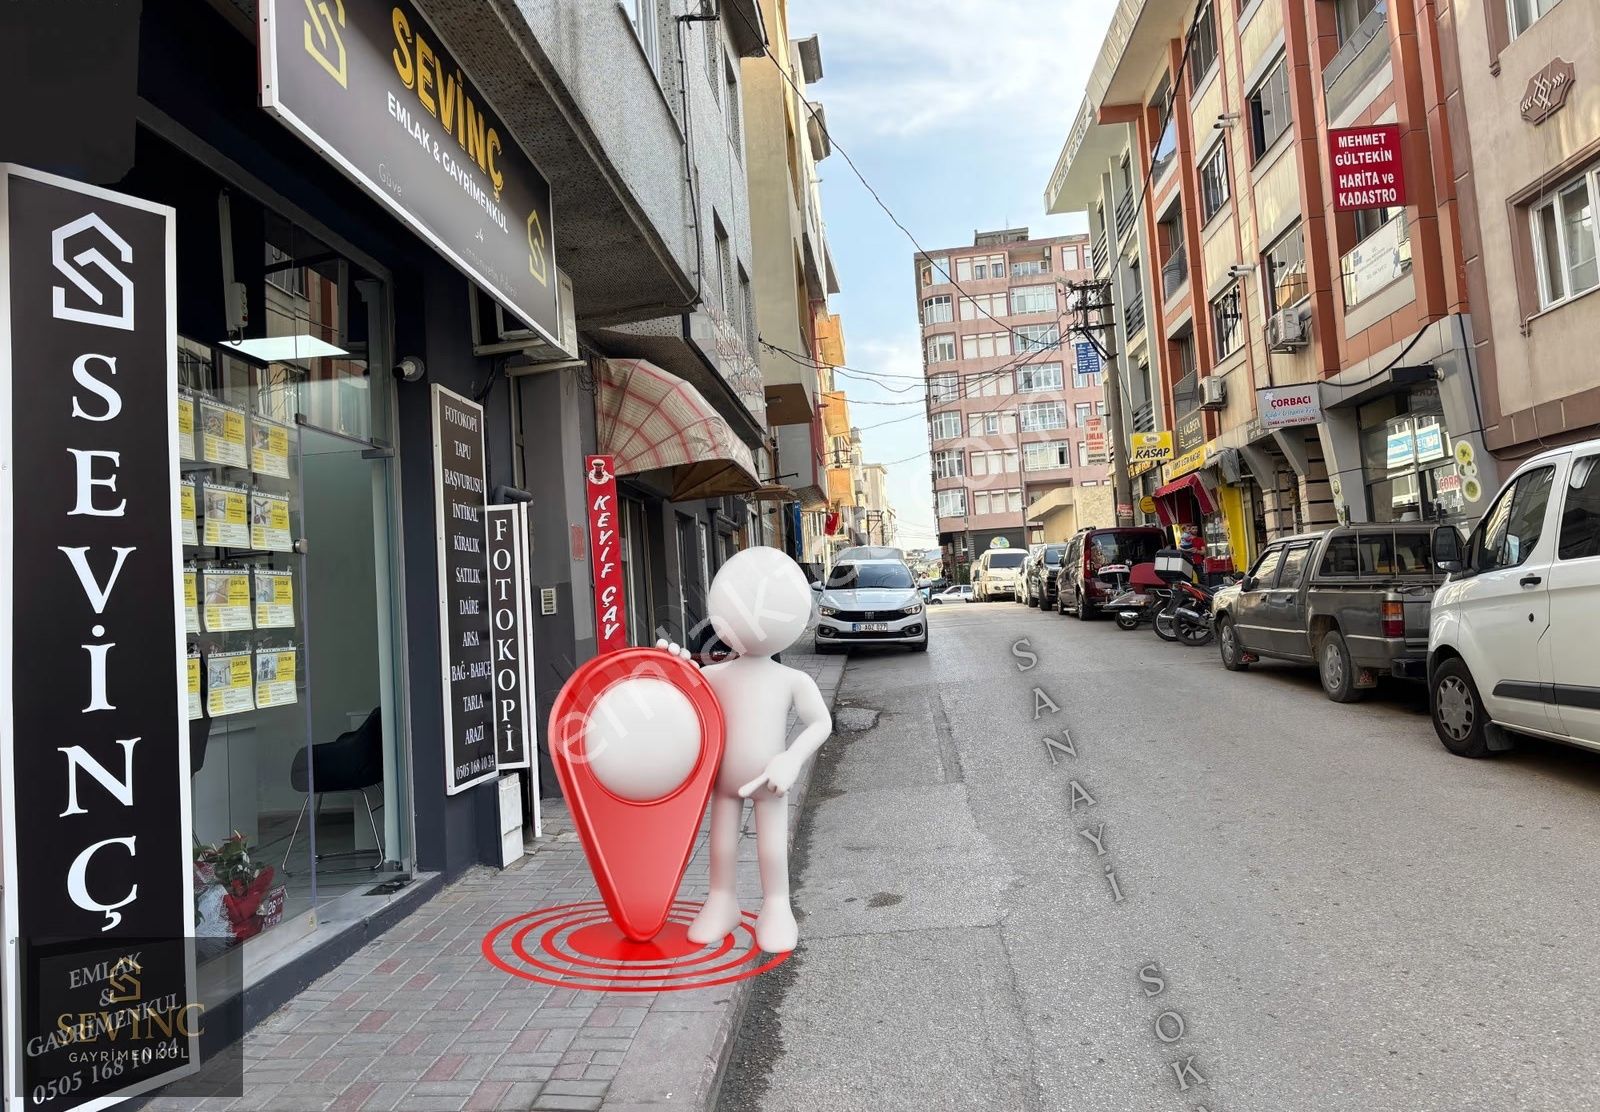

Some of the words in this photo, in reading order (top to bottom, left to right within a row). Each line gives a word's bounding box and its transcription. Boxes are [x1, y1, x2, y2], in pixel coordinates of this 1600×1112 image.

[392, 7, 504, 203] SEVİNÇ
[1338, 133, 1386, 148] MEHMET
[387, 90, 431, 154] EMLAK
[433, 140, 441, 163] &
[442, 151, 509, 234] GAYRİMENKUL
[1335, 148, 1393, 166] GÜLTEKİN
[1339, 170, 1379, 188] HARİTA
[1382, 174, 1394, 184] ve
[1339, 188, 1397, 206] KADASTRO
[1271, 396, 1312, 409] ÇORBACI
[445, 405, 478, 433] FOTOKOPİ
[454, 440, 471, 460] TAPU
[1135, 447, 1170, 459] KASAP
[444, 468, 483, 494] BAŞVURUSU
[452, 498, 479, 523] İNTİKAL
[454, 531, 480, 553] KİRALIK
[593, 495, 615, 579] KEYİF
[456, 567, 481, 584] SATILIK
[459, 596, 480, 615] DAİRE
[601, 586, 620, 640] ÇAY
[57, 353, 142, 932] SEVİNÇ
[462, 631, 480, 647] ARSA
[493, 519, 516, 752] FOTOKOPİ
[452, 661, 466, 682] BAĞ
[470, 660, 491, 680] BAHÇE
[462, 693, 484, 713] TARLA
[464, 721, 485, 745] ARAZİ
[455, 763, 470, 780] 0505
[470, 759, 480, 774] 168
[480, 757, 487, 770] 10
[487, 754, 495, 768] 34
[69, 951, 142, 990] EMLAK
[100, 988, 114, 1007] &
[26, 993, 181, 1058] GAYRİMENKUL
[33, 1070, 83, 1105] 0505
[91, 1056, 124, 1085] 168
[132, 1049, 153, 1069] 10
[158, 1037, 179, 1059] 34
